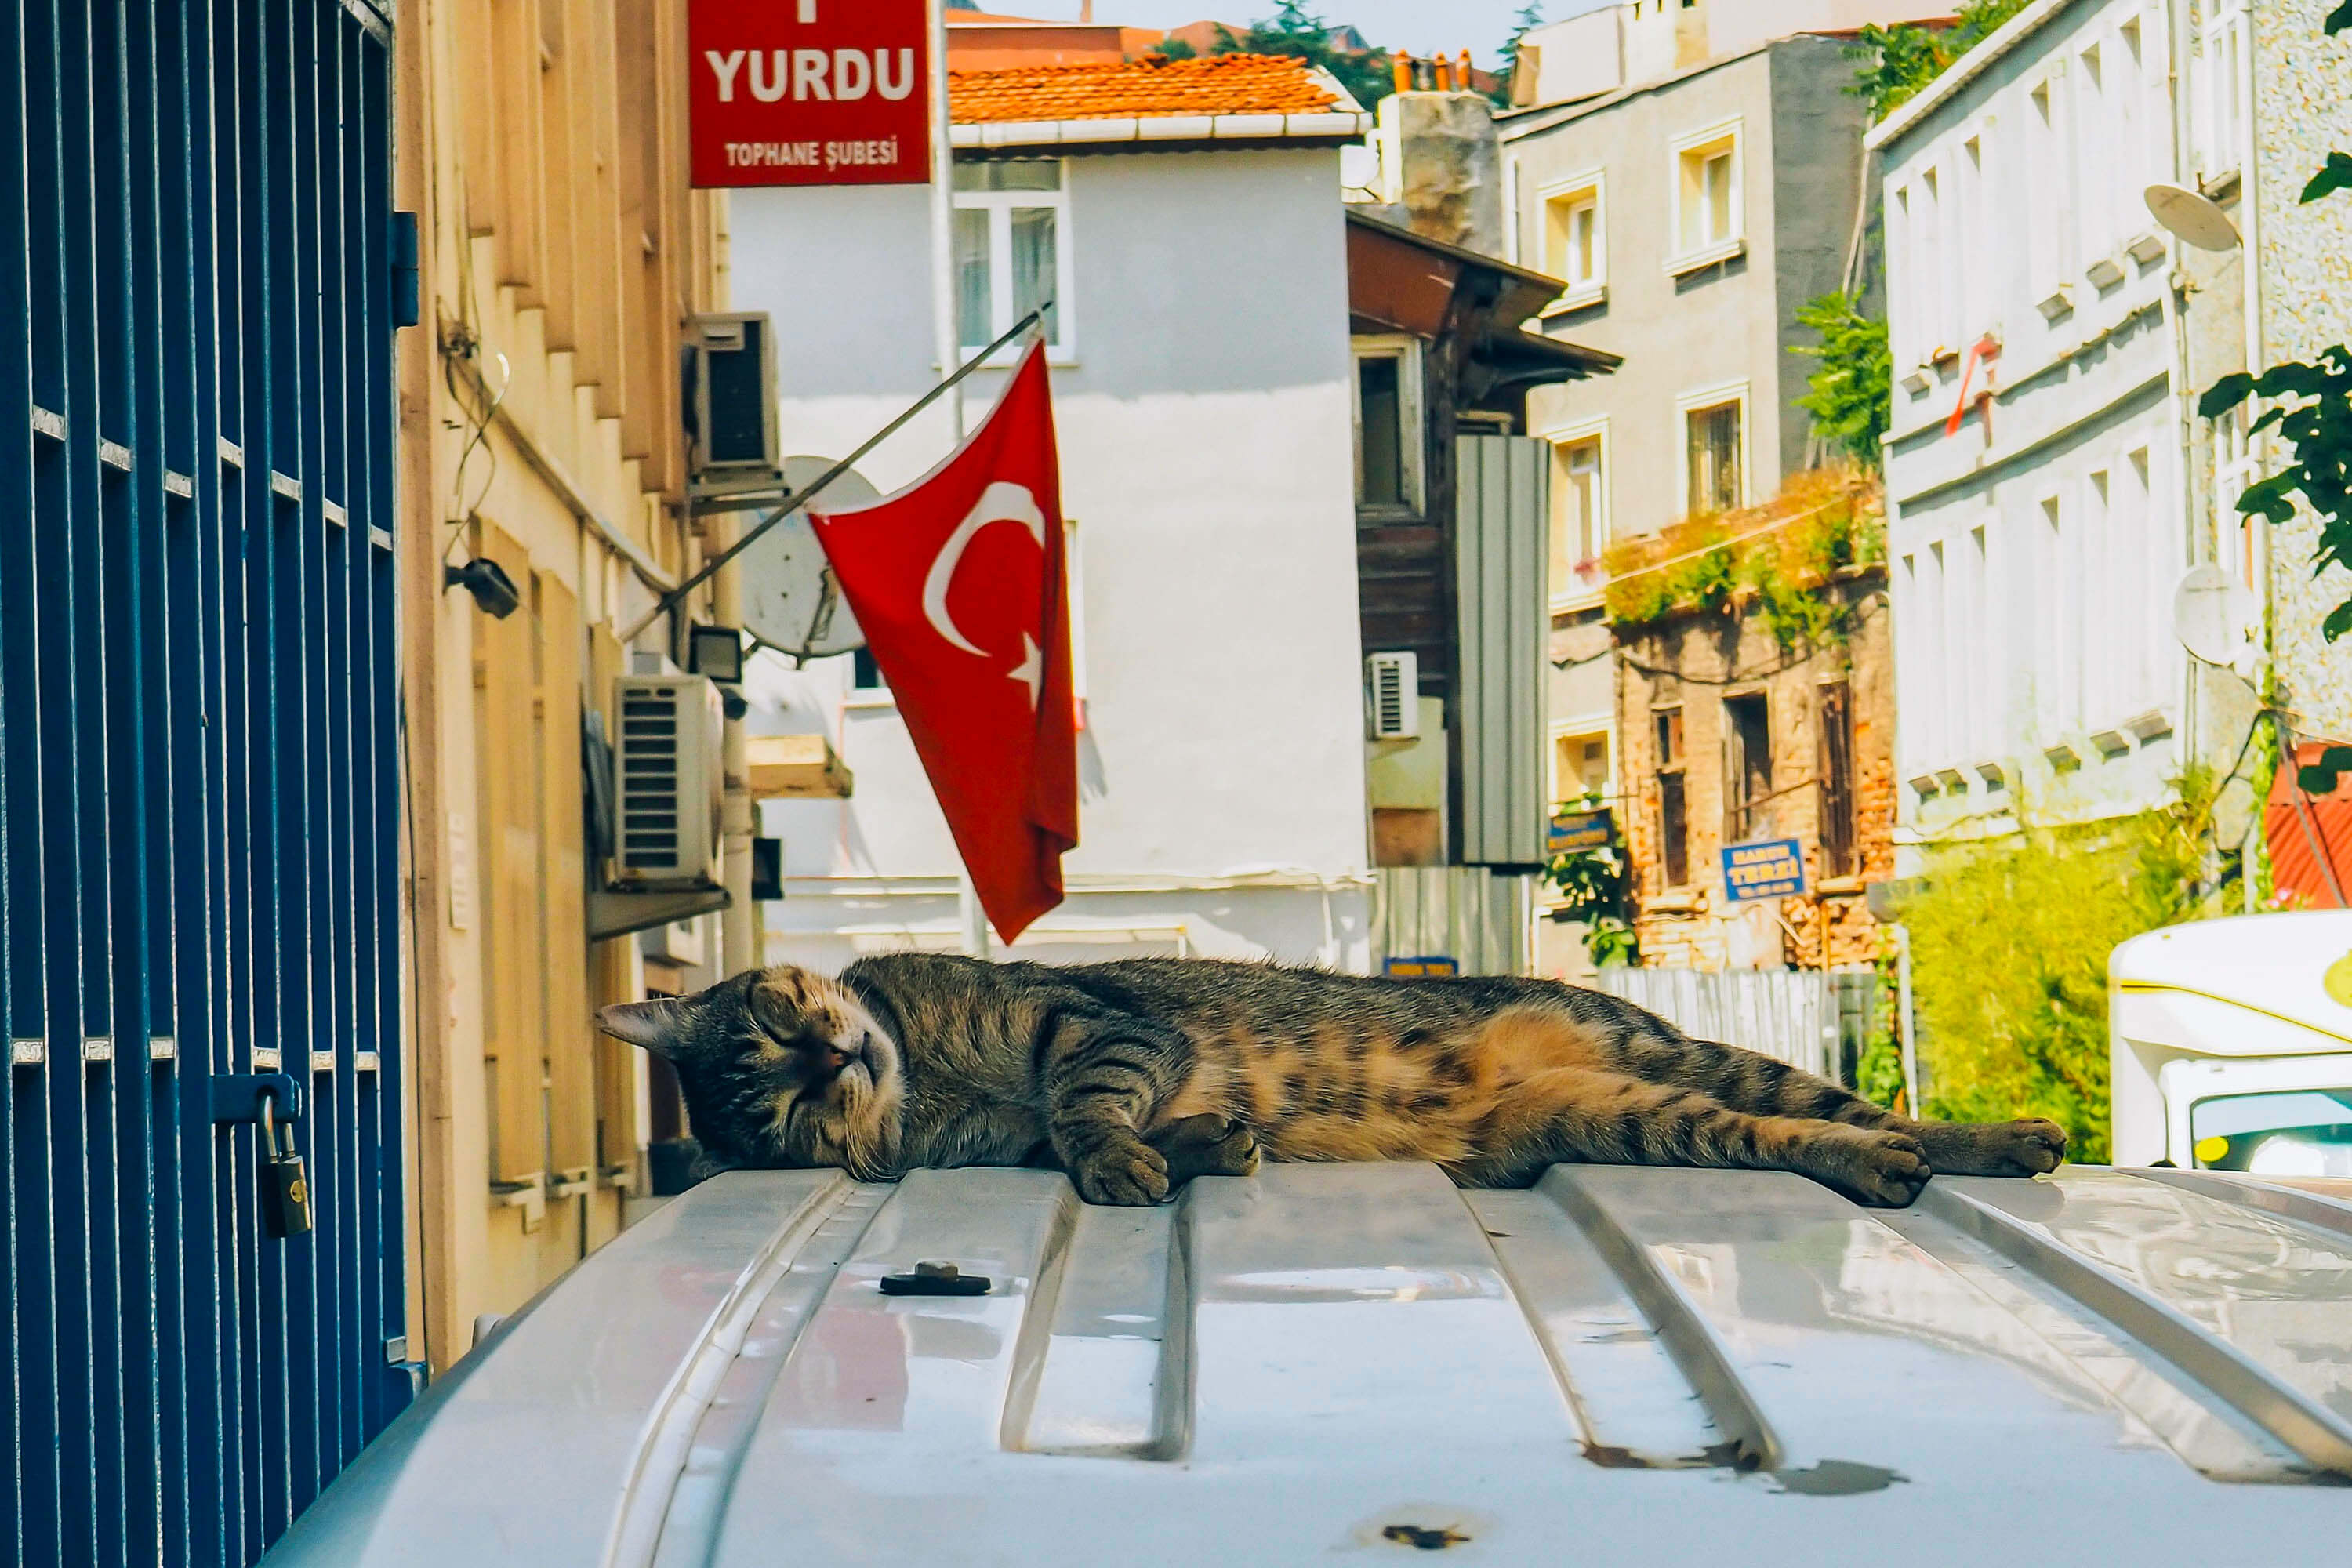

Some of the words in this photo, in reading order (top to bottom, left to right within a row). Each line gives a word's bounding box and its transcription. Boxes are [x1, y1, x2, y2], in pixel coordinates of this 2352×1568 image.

[705, 48, 914, 102] YURDU
[724, 142, 820, 166] TOPHANE
[826, 134, 898, 172] ŞUBESİ
